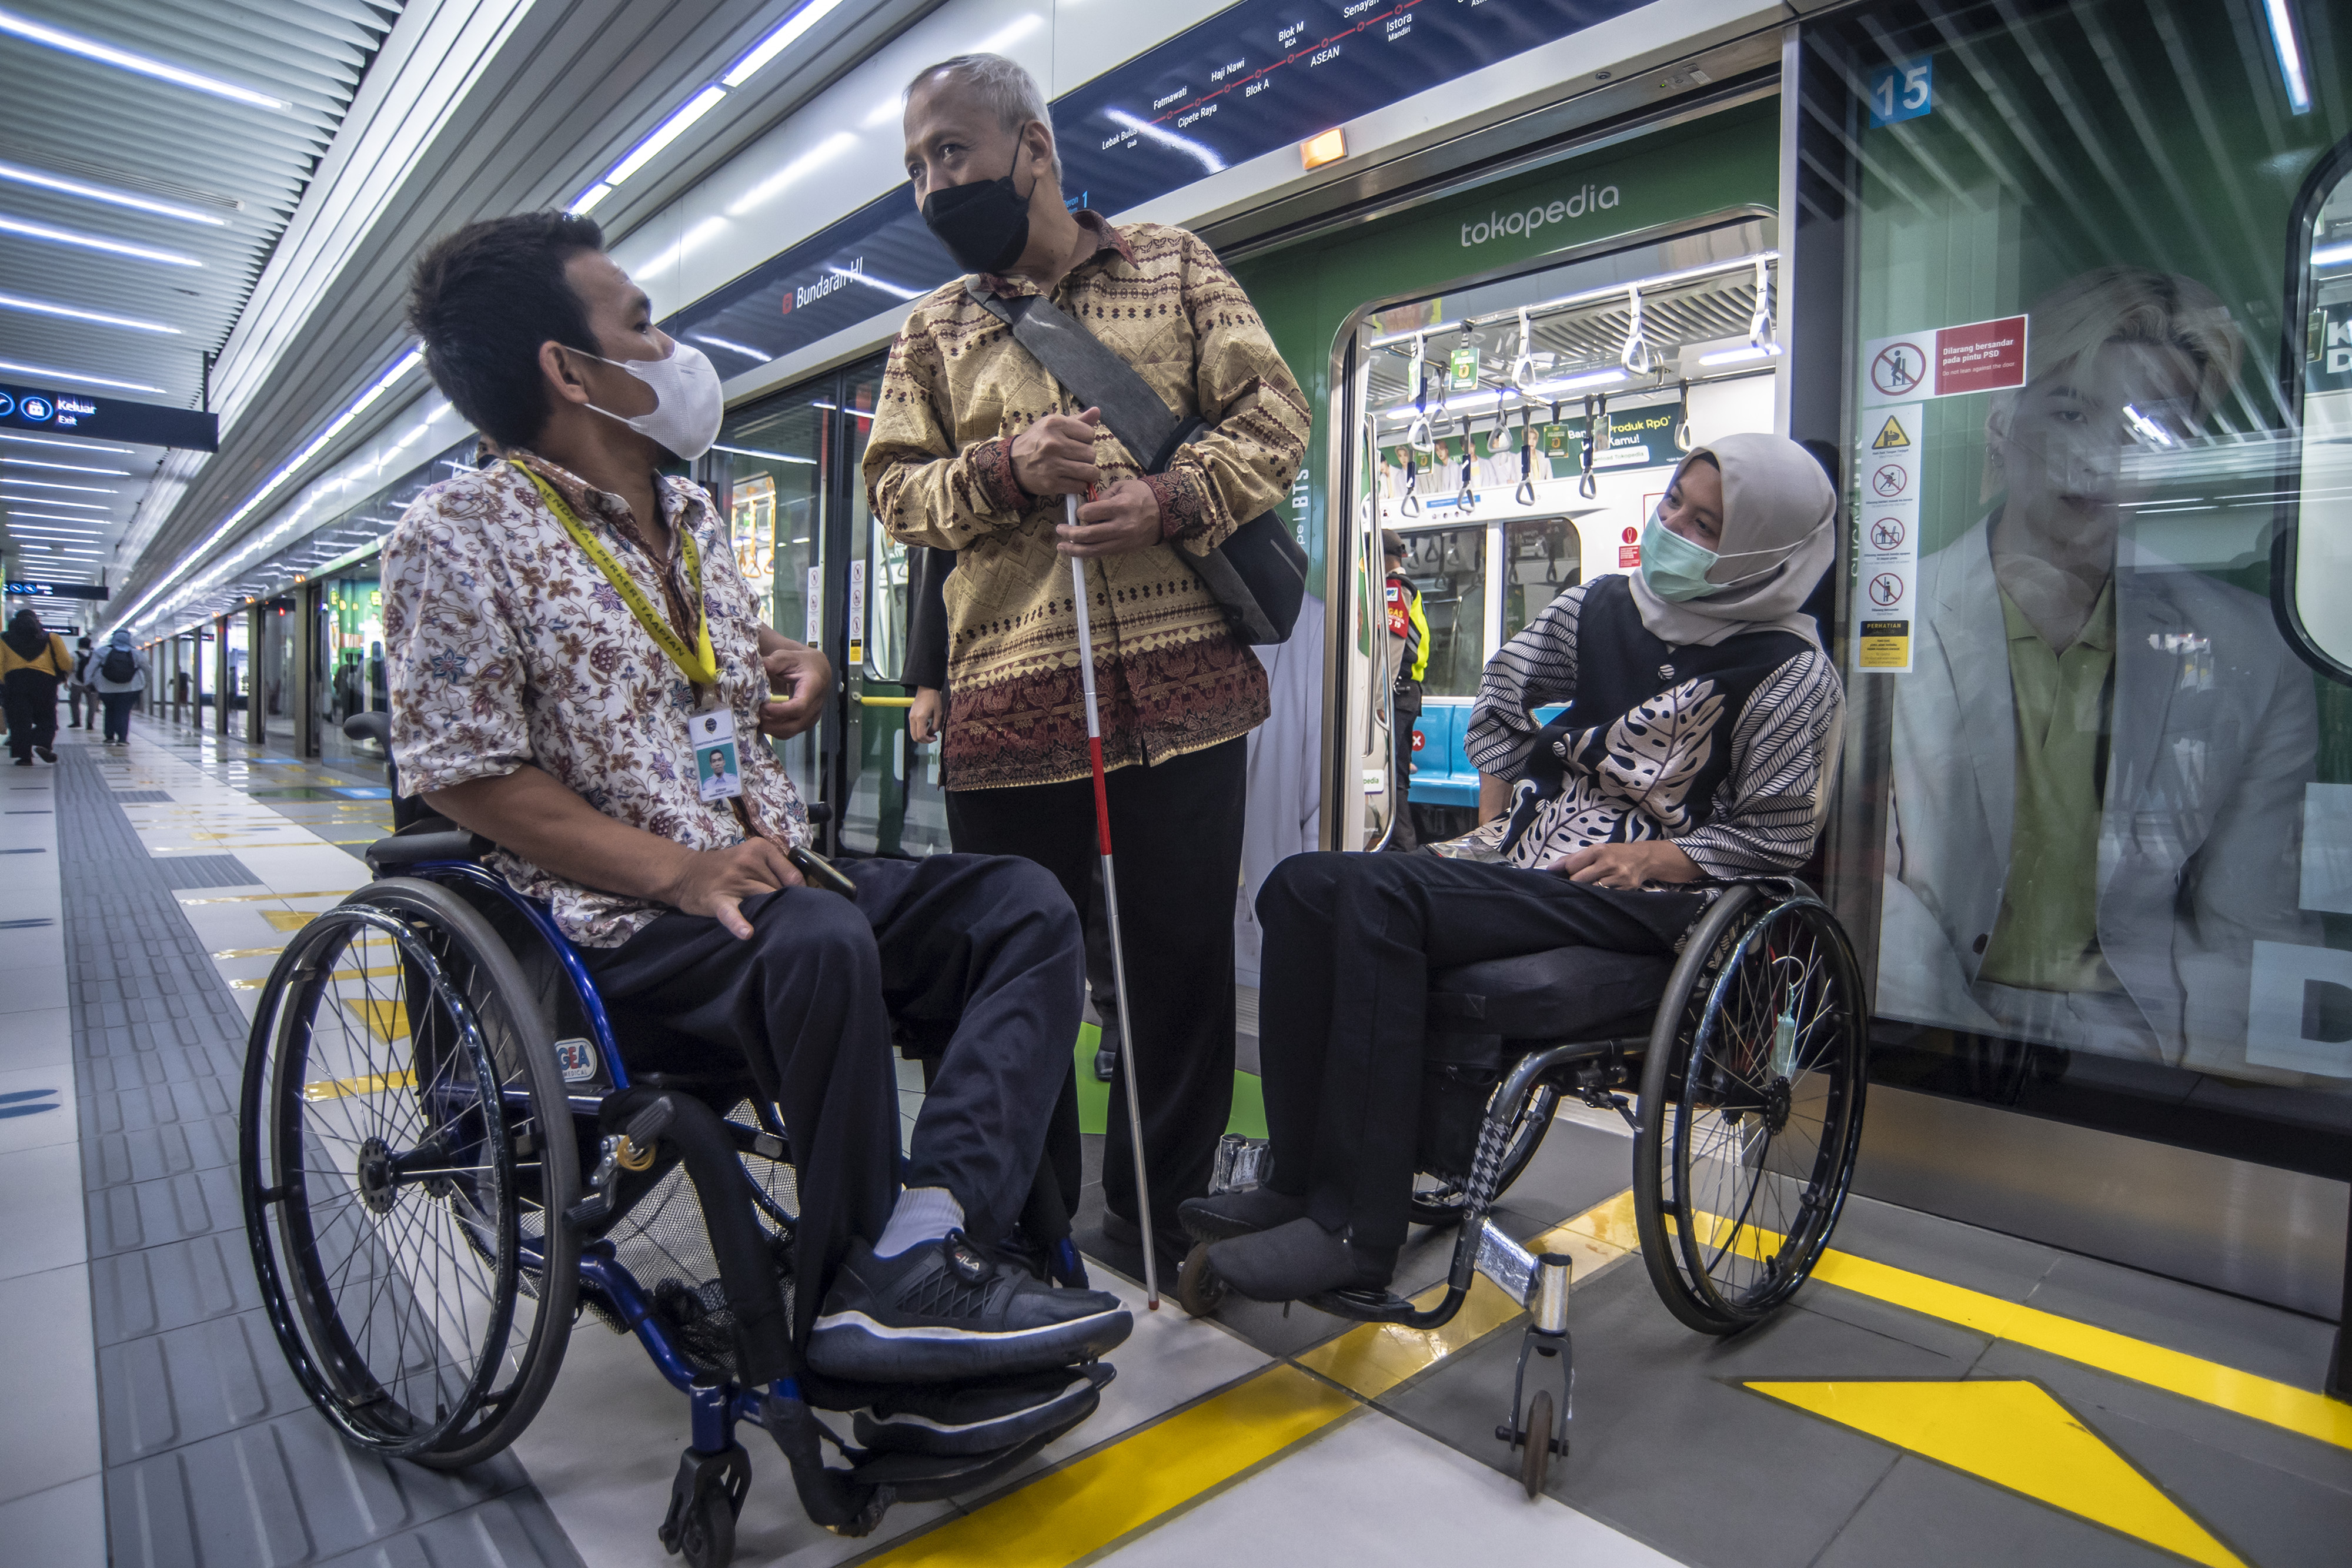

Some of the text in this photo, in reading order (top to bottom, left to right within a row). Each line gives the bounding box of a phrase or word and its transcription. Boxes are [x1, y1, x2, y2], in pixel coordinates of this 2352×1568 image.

[1279, 21, 1304, 42] Blok M
[1387, 13, 1412, 33] Istora
[1388, 25, 1411, 42] Mandiri
[1285, 37, 1297, 49] BCA
[1311, 45, 1340, 68] ASEAN
[1211, 58, 1245, 82] Haji Nawi
[1154, 86, 1187, 110] Fatmawati
[1246, 78, 1269, 98] Blok A
[1876, 66, 1928, 116] 15
[1178, 104, 1217, 128] Cipete Raya
[1102, 128, 1138, 150] Lebak Bulus
[1082, 190, 1088, 208] 1
[1461, 185, 1619, 247] tokopedia
[797, 273, 847, 309] Bundaran
[1943, 339, 2014, 355] Dilarang bersandar
[1943, 350, 1999, 366] pada pintu PSD
[1972, 365, 1992, 373] against
[58, 400, 97, 415] Keluar
[58, 416, 78, 426] Exit
[1292, 469, 1309, 509] BTS
[597, 549, 686, 657] PERKERETAAPIAN
[557, 1045, 590, 1071] GEA
[955, 1253, 980, 1271] FILA
